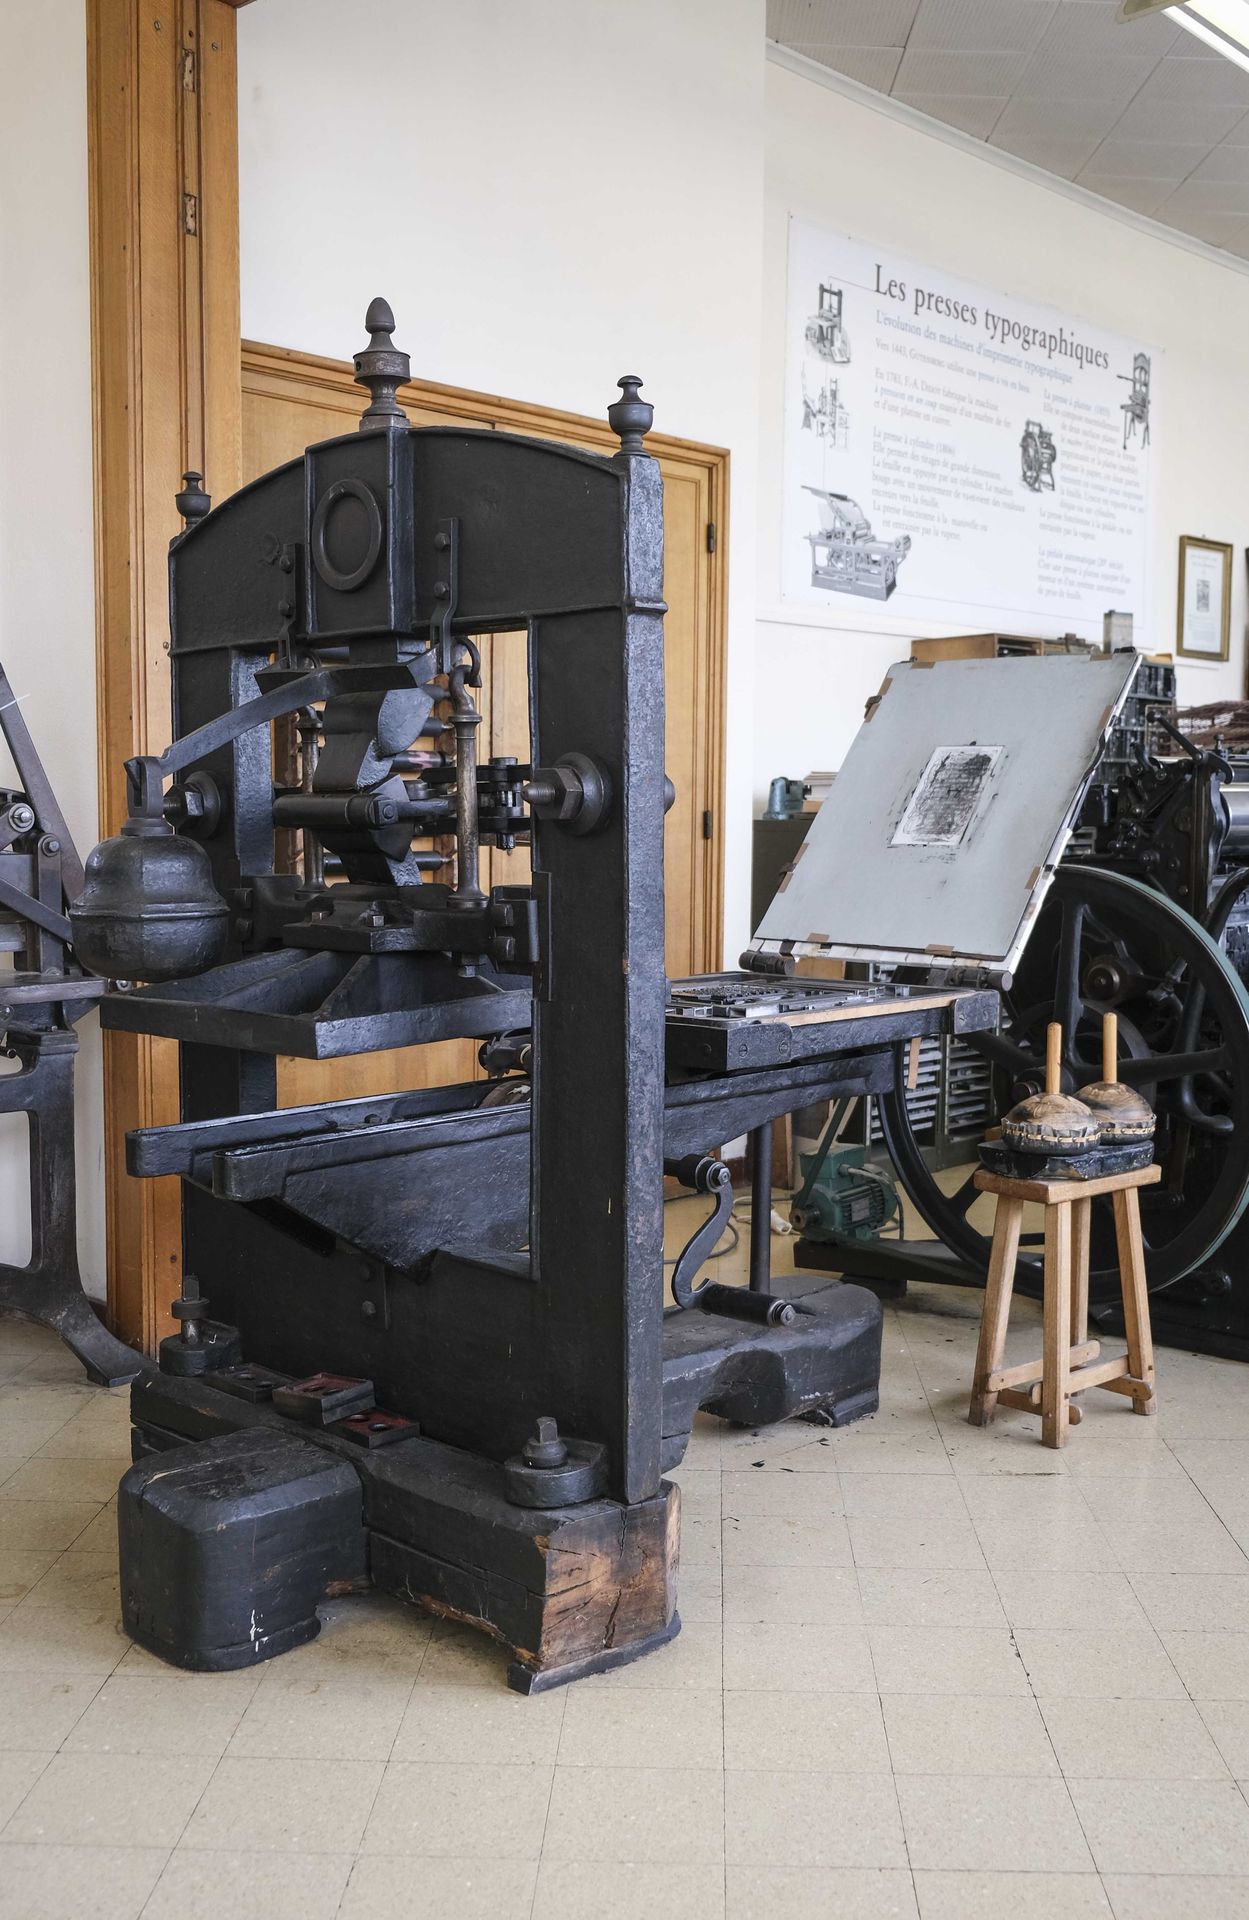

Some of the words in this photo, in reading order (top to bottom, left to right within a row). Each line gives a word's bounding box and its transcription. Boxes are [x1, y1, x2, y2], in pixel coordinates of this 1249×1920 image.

[874, 263, 906, 301] Les
[914, 286, 977, 326] presses
[984, 308, 1110, 369] typographiques
[876, 309, 921, 336] L'évolution
[924, 324, 937, 341] des
[939, 334, 974, 352] machines
[1025, 359, 1072, 385] typographique
